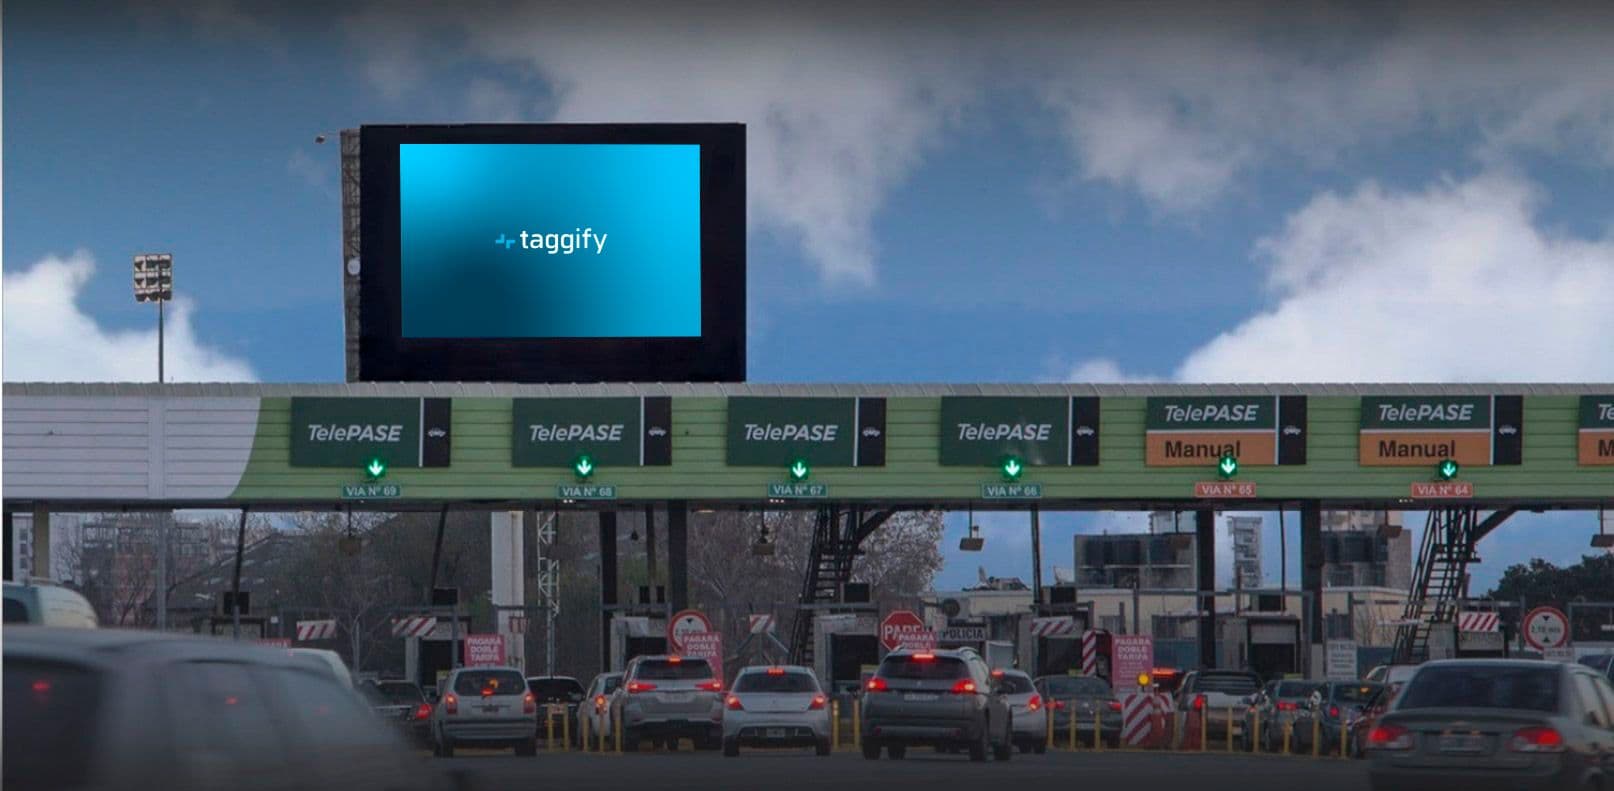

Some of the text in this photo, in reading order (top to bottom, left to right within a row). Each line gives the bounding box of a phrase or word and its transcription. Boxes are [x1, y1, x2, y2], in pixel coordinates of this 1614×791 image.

[519, 227, 608, 255] taggify
[1165, 404, 1260, 421] TelePASE
[1378, 404, 1474, 421] TelePASE
[308, 424, 403, 442] TelePASE
[529, 424, 624, 441] TelePASE
[744, 423, 839, 441] TelePASE
[957, 423, 1052, 441] TelePASE
[1165, 440, 1241, 458] Manual
[1378, 440, 1456, 458] Manual
[346, 486, 366, 497] VIA
[383, 486, 397, 497] 69
[562, 487, 582, 497] VIA
[599, 487, 612, 497] 68
[773, 485, 793, 496] VIA
[810, 485, 823, 496] 67
[987, 486, 1007, 497] VIA
[1024, 486, 1038, 497] 66
[1202, 485, 1221, 496] VIA
[1238, 485, 1252, 496] 65
[1417, 485, 1437, 496] VIA
[1455, 485, 1468, 496] 64
